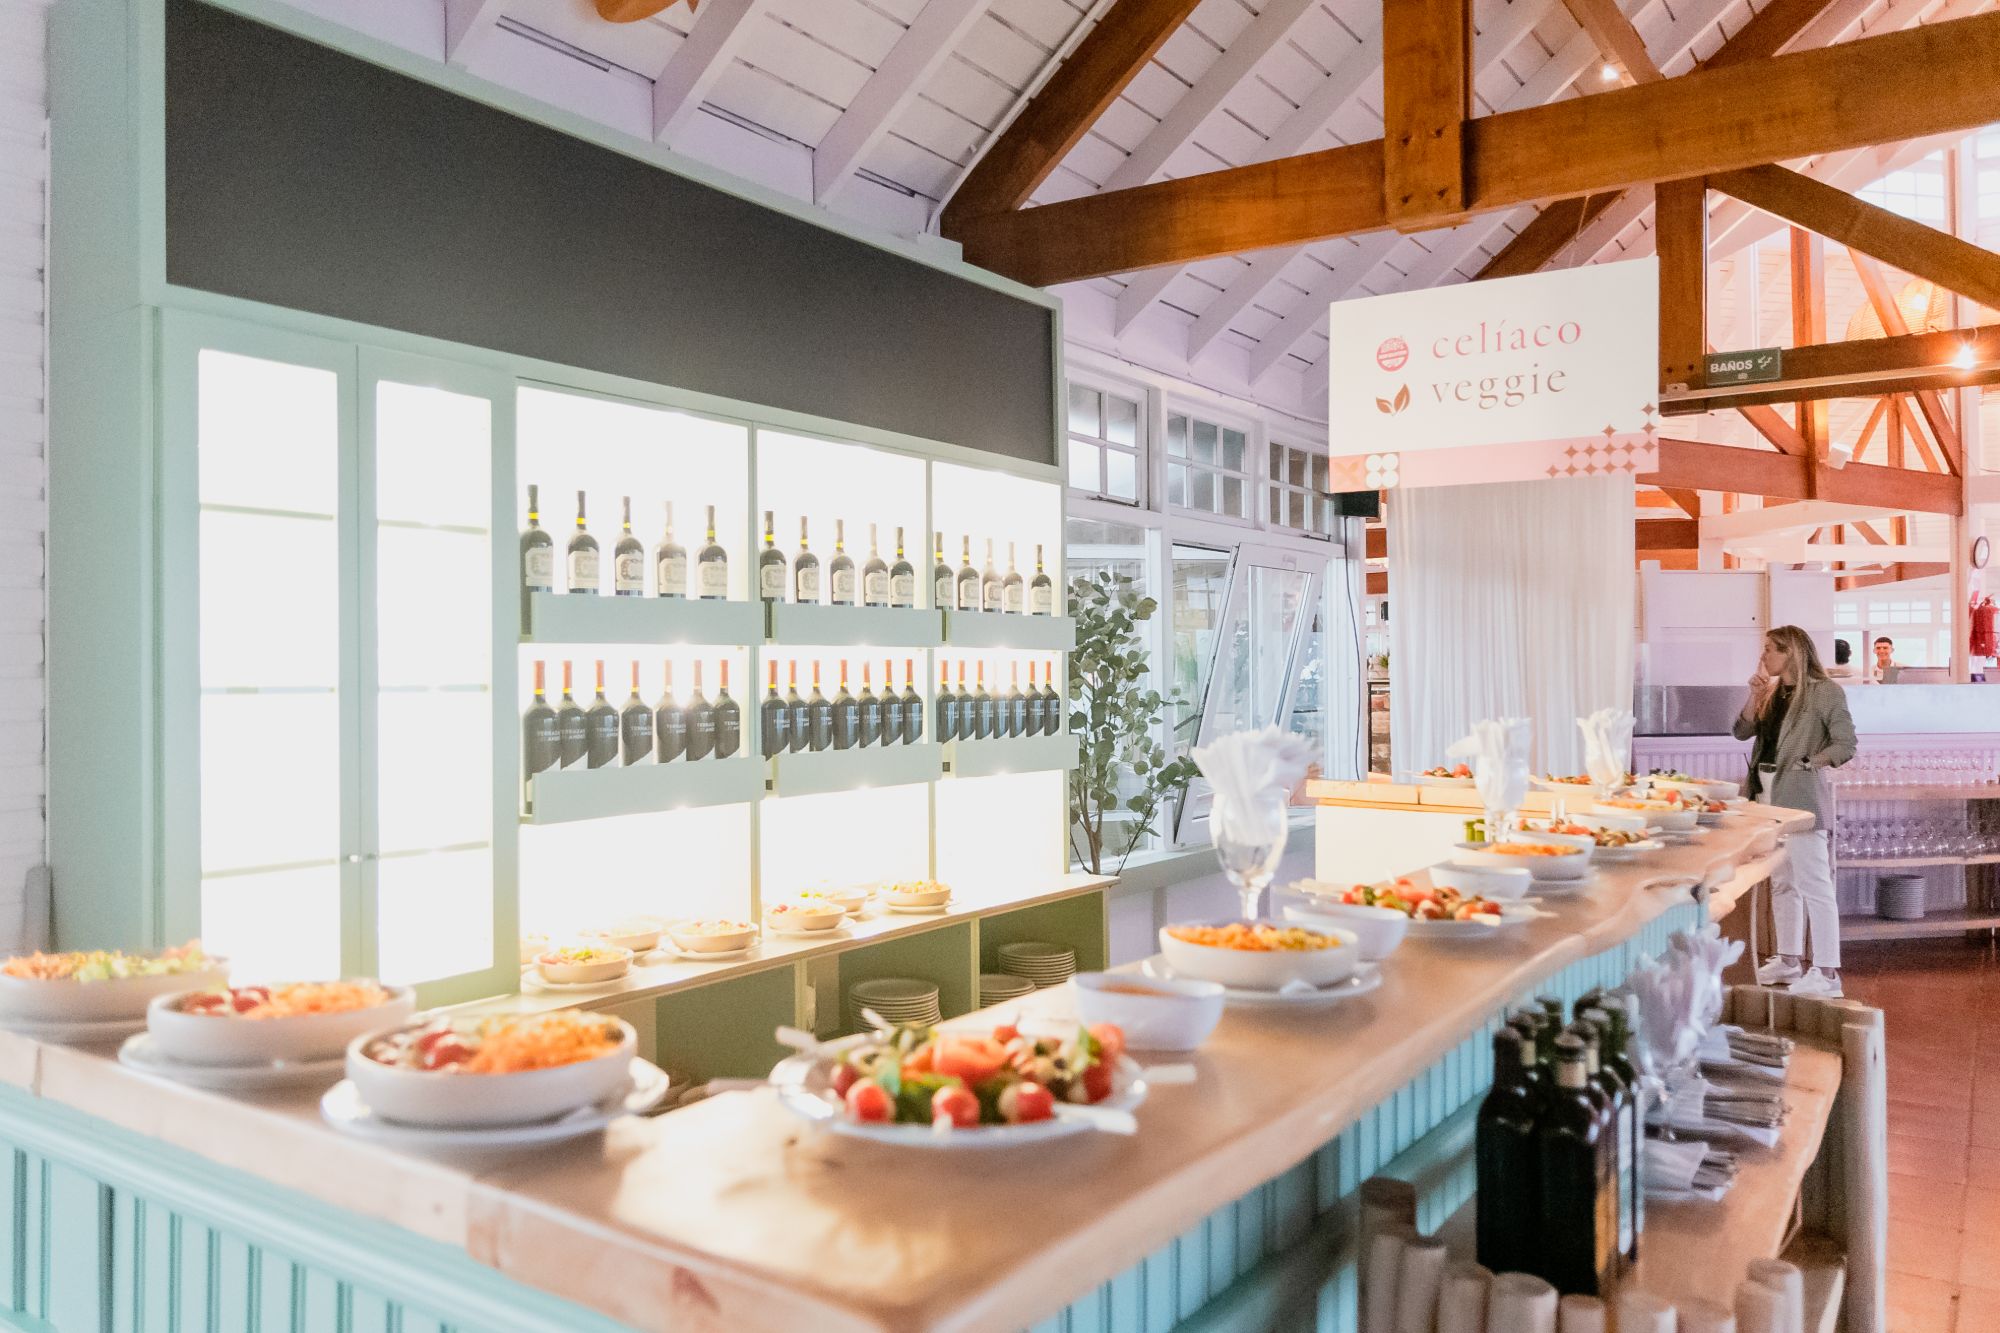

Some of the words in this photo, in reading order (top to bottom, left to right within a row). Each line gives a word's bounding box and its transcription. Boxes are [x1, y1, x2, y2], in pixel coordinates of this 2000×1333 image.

[1432, 319, 1581, 359] celíaco
[1432, 363, 1566, 410] veggie
[1710, 360, 1753, 373] BAÑOS
